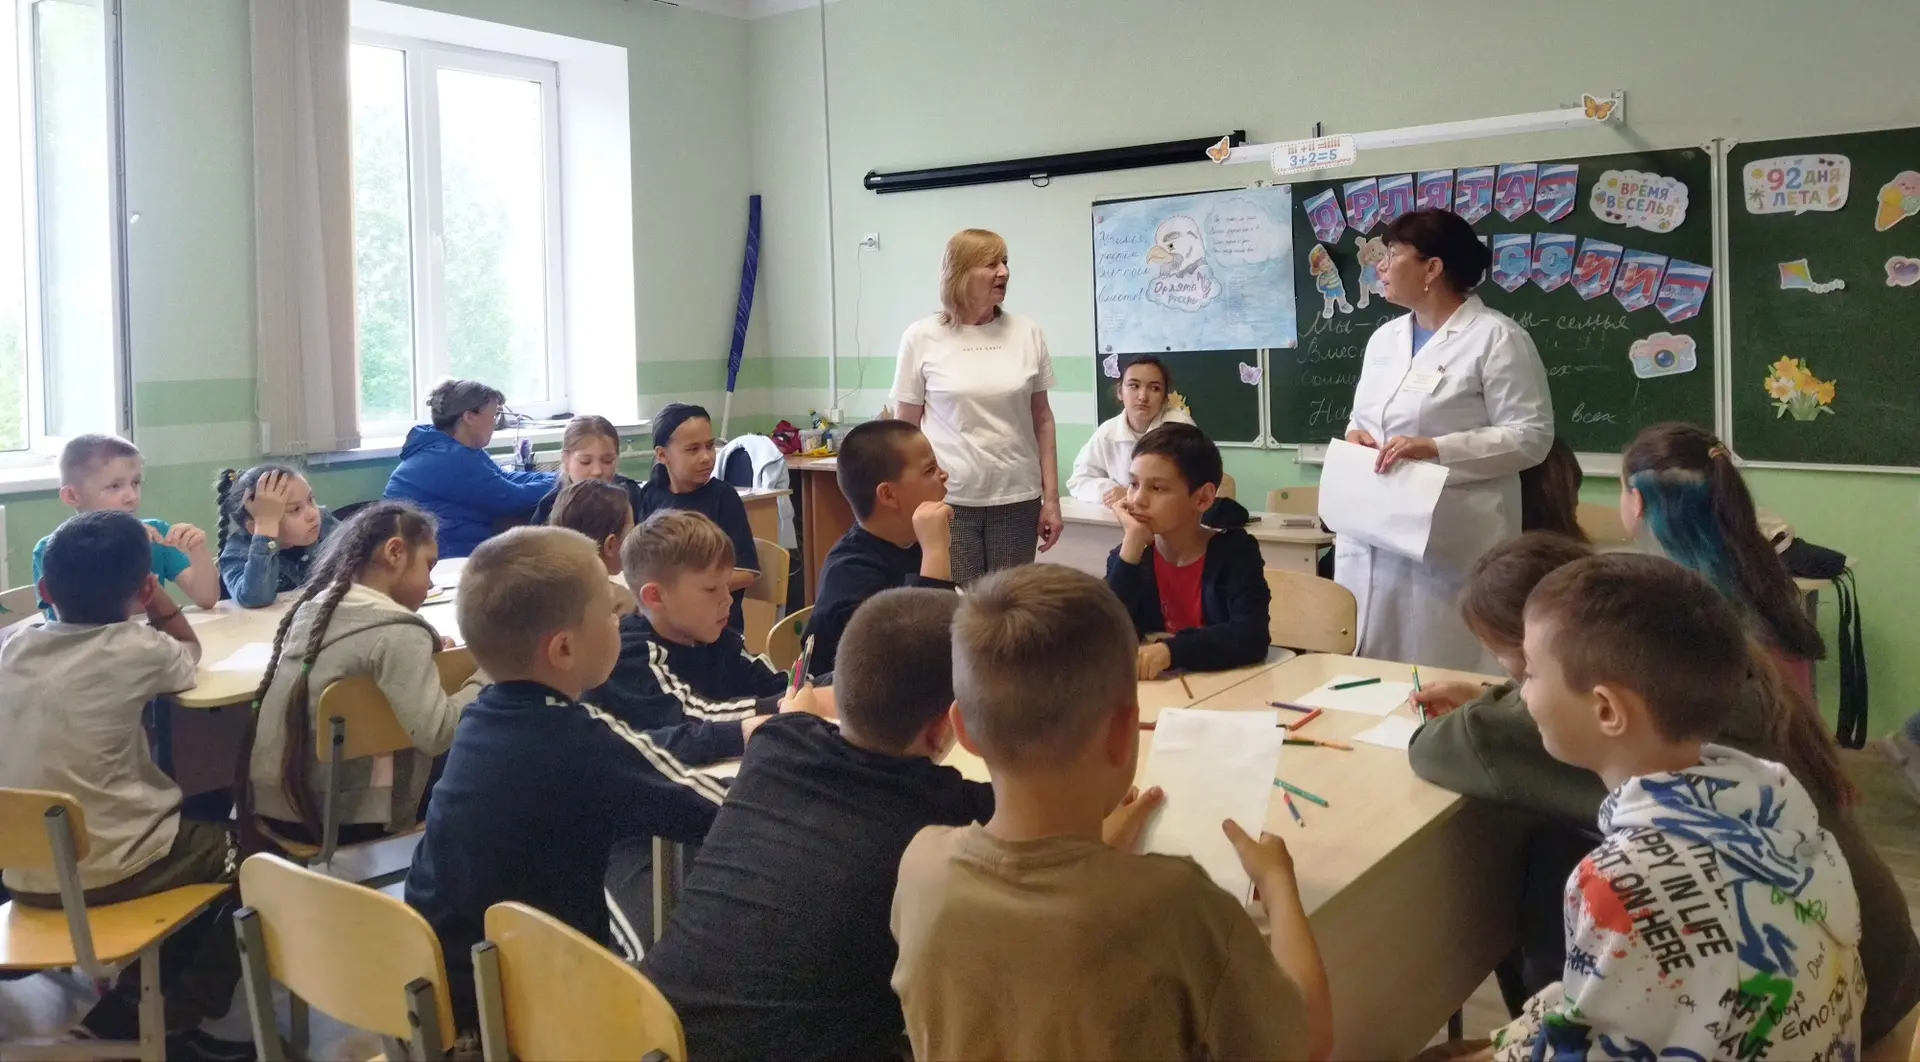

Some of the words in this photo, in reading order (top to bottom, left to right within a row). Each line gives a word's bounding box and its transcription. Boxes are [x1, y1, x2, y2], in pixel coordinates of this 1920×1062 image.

[1289, 148, 1338, 167] 3+2=5
[1620, 182, 1669, 200] ВРЕМЯ
[1767, 167, 1803, 190] 92
[1803, 167, 1841, 185] ДНЯ
[1314, 174, 1530, 230] ОРЛЯТА
[1606, 197, 1674, 218] ВЕСЕЛЬЯ
[1772, 190, 1821, 207] ЛЕТА
[1499, 245, 1657, 296] ССИИ
[1610, 873, 1658, 911] ON
[1660, 873, 1704, 902] IN
[1631, 909, 1695, 974] HERE
[1677, 902, 1734, 957] LIFE
